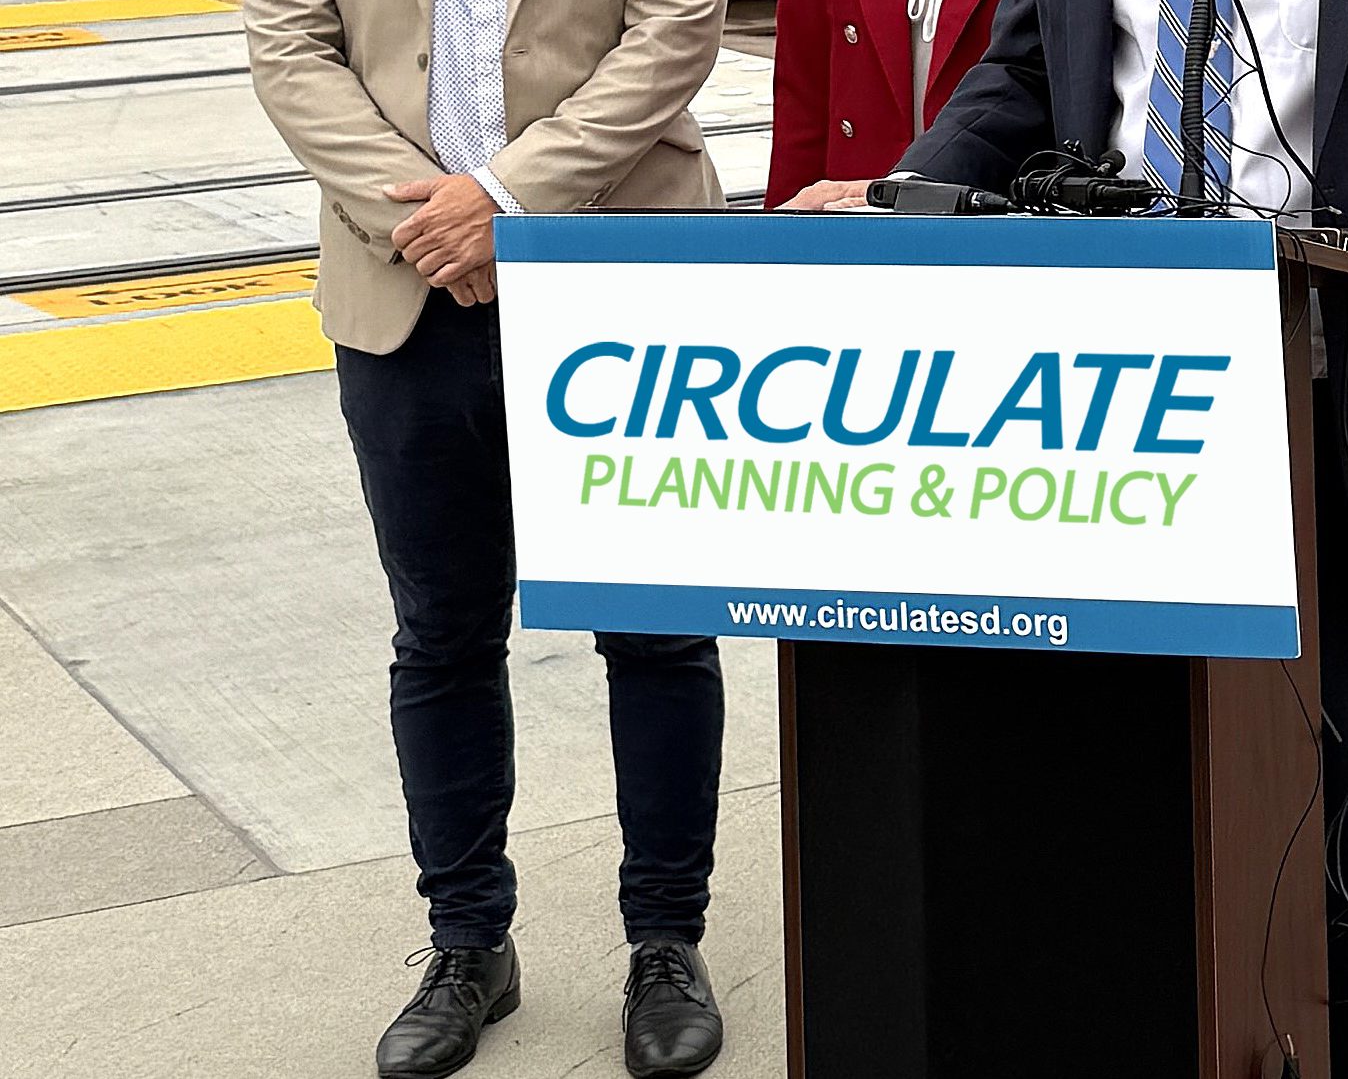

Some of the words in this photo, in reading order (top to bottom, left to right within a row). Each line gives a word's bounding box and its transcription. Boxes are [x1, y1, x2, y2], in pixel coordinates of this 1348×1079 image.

[546, 341, 1232, 455] CIRCULATE
[580, 455, 896, 516] PLANNING
[910, 464, 955, 518] &
[969, 467, 1198, 527] POLICY
[727, 599, 1069, 646] www.circulatesd.org
